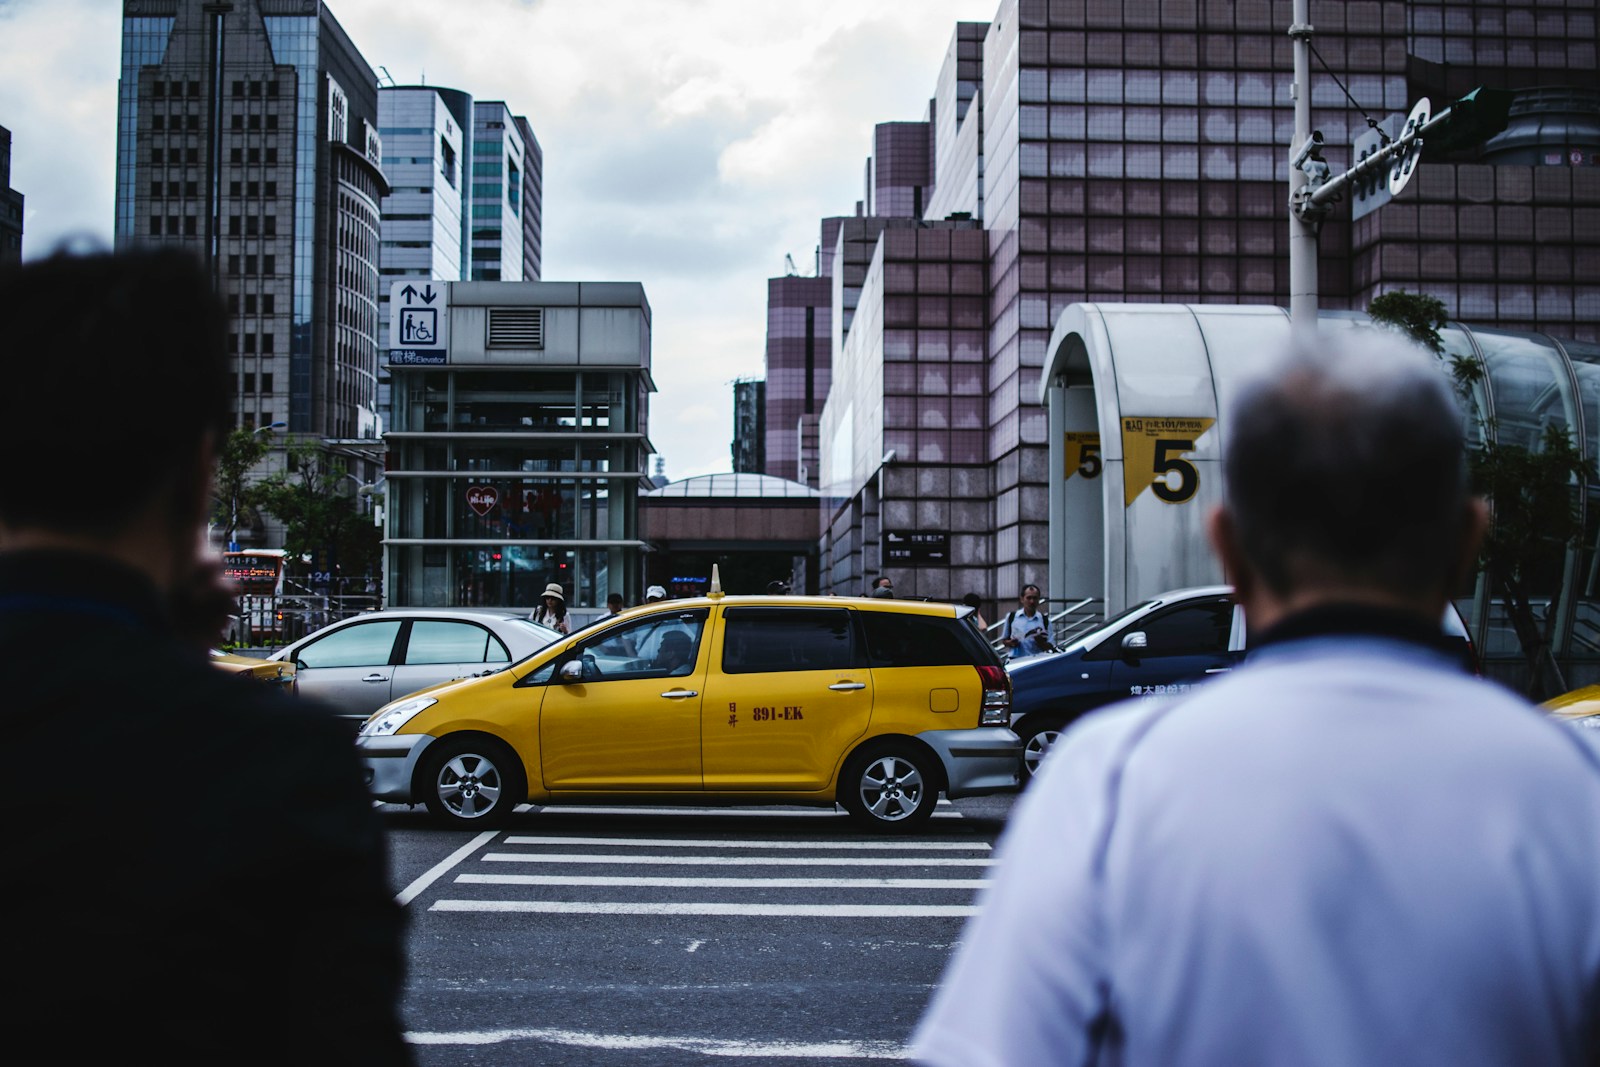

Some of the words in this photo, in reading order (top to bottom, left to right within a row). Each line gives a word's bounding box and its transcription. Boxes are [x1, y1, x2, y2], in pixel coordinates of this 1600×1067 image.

[390, 350, 416, 364] 電梯
[416, 356, 445, 364] Elevator
[1078, 444, 1102, 479] 5
[1151, 439, 1198, 502] 5
[470, 492, 495, 508] Hi-Life
[314, 571, 331, 583] 24
[752, 706, 804, 721] 891-EK
